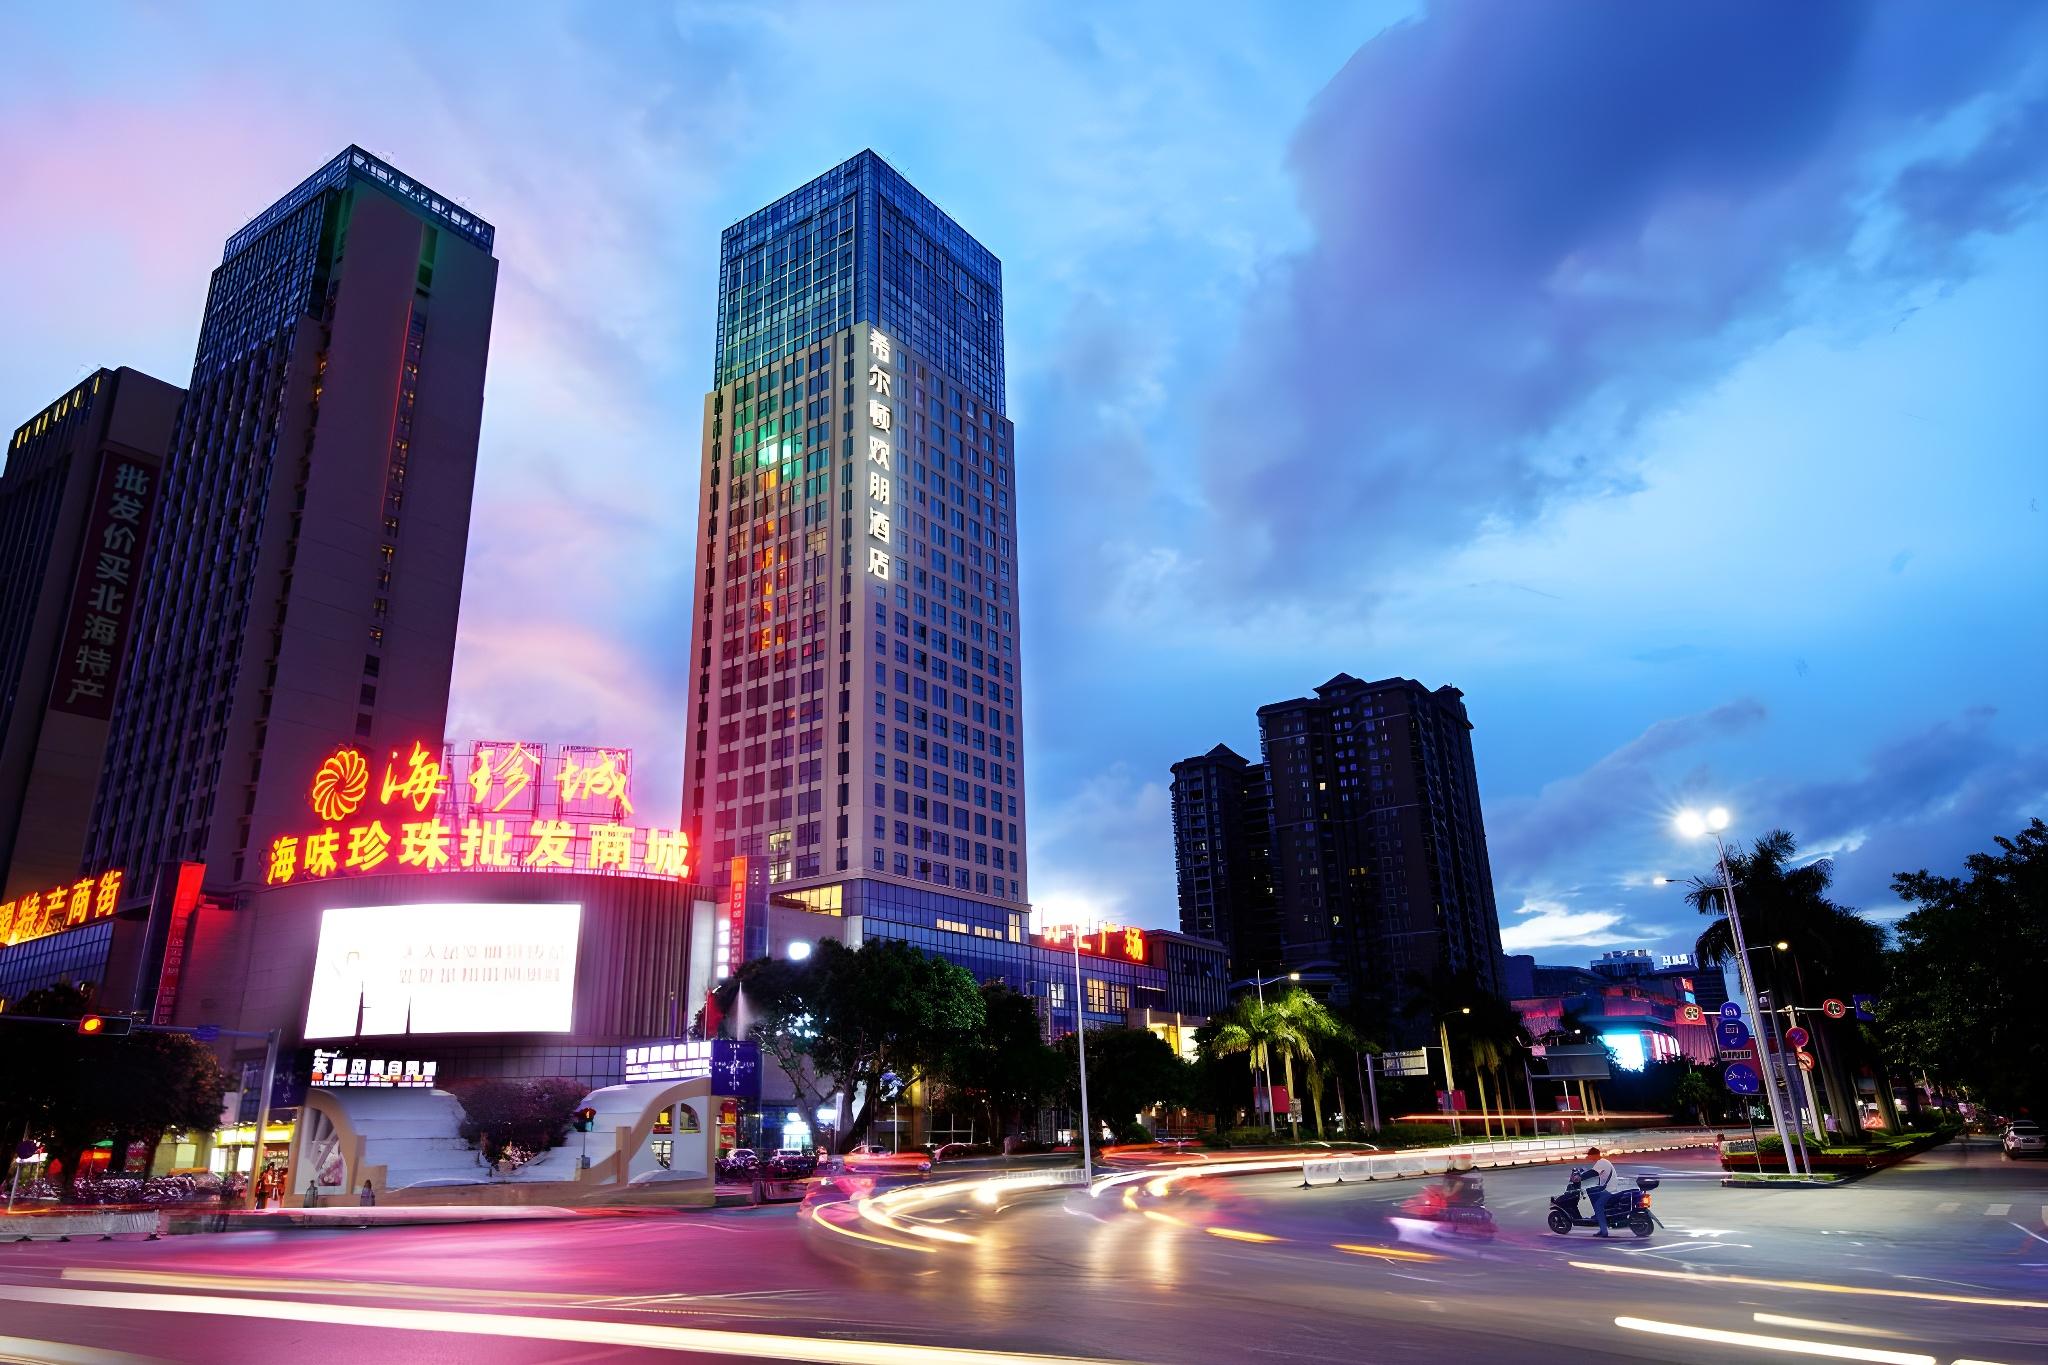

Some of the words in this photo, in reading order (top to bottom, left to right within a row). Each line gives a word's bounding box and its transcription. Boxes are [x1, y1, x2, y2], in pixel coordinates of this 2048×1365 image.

[868, 328, 891, 581] 希尔顿欢朋酒店
[66, 463, 150, 704] 批发价买北海特产
[267, 819, 690, 885] 海味珍珠批发商城
[381, 740, 633, 813] 海珍城
